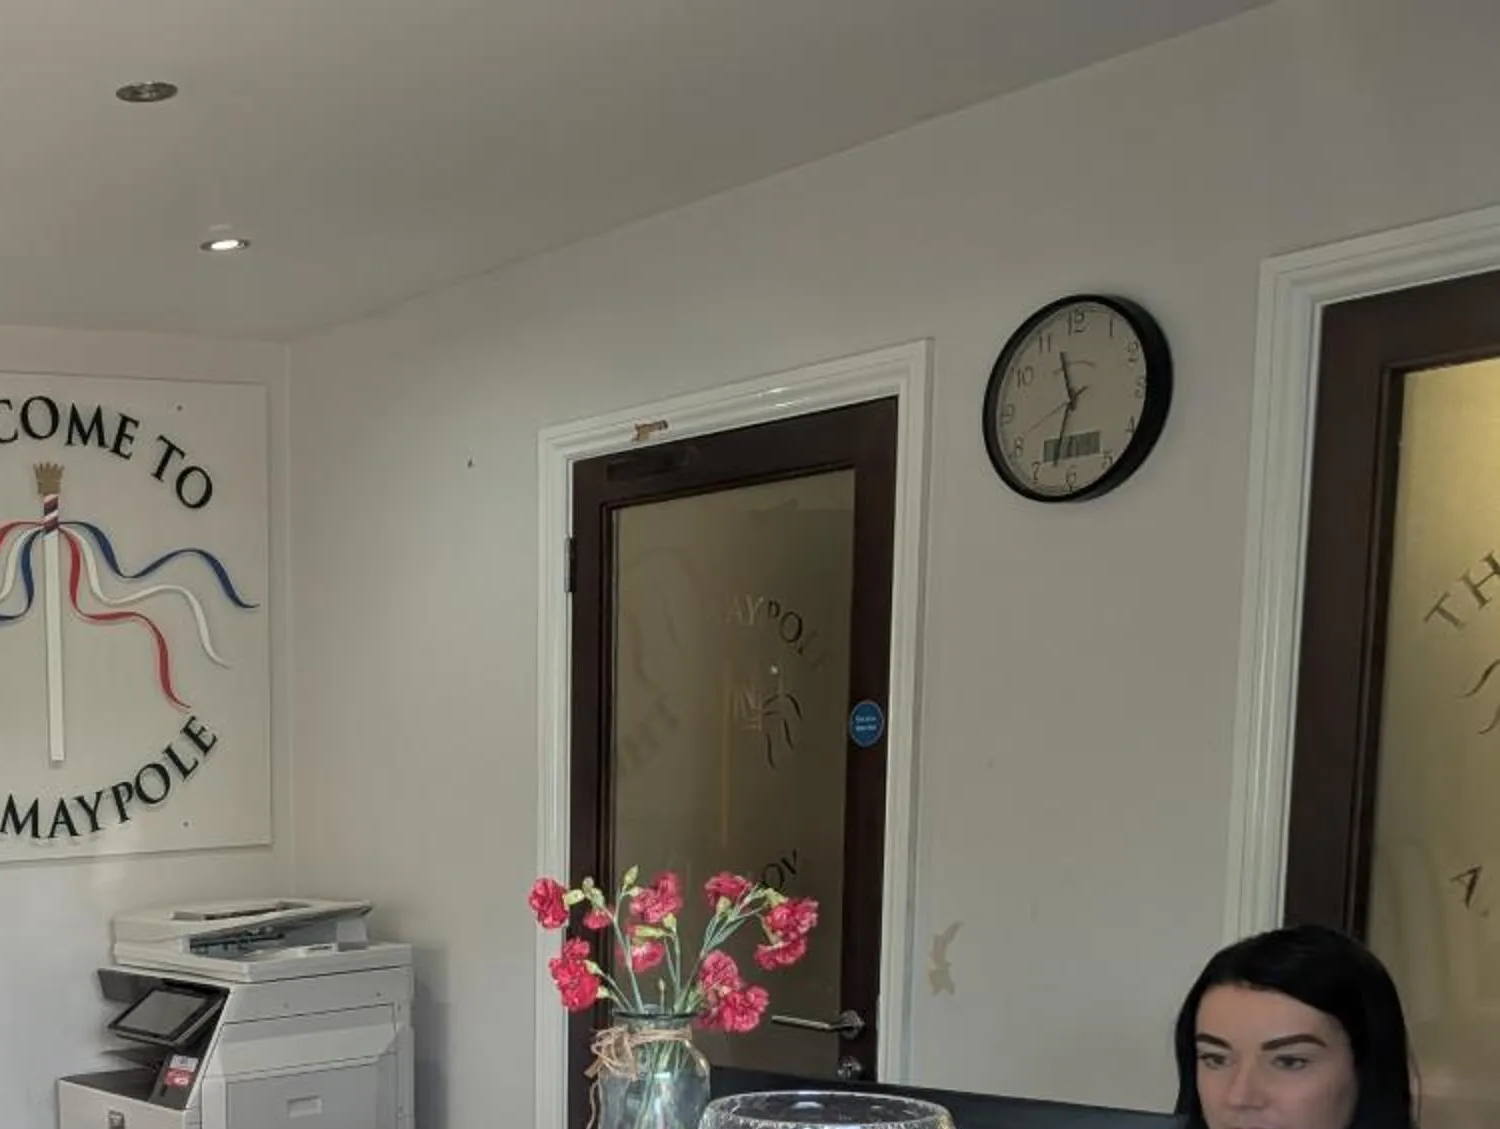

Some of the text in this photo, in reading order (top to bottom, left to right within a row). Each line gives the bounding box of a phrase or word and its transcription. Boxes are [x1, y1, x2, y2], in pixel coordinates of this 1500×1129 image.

[1067, 309, 1087, 336] 12
[1015, 365, 1035, 389] 10
[151, 435, 213, 509] TO
[0, 715, 219, 840] MAYPOLE
